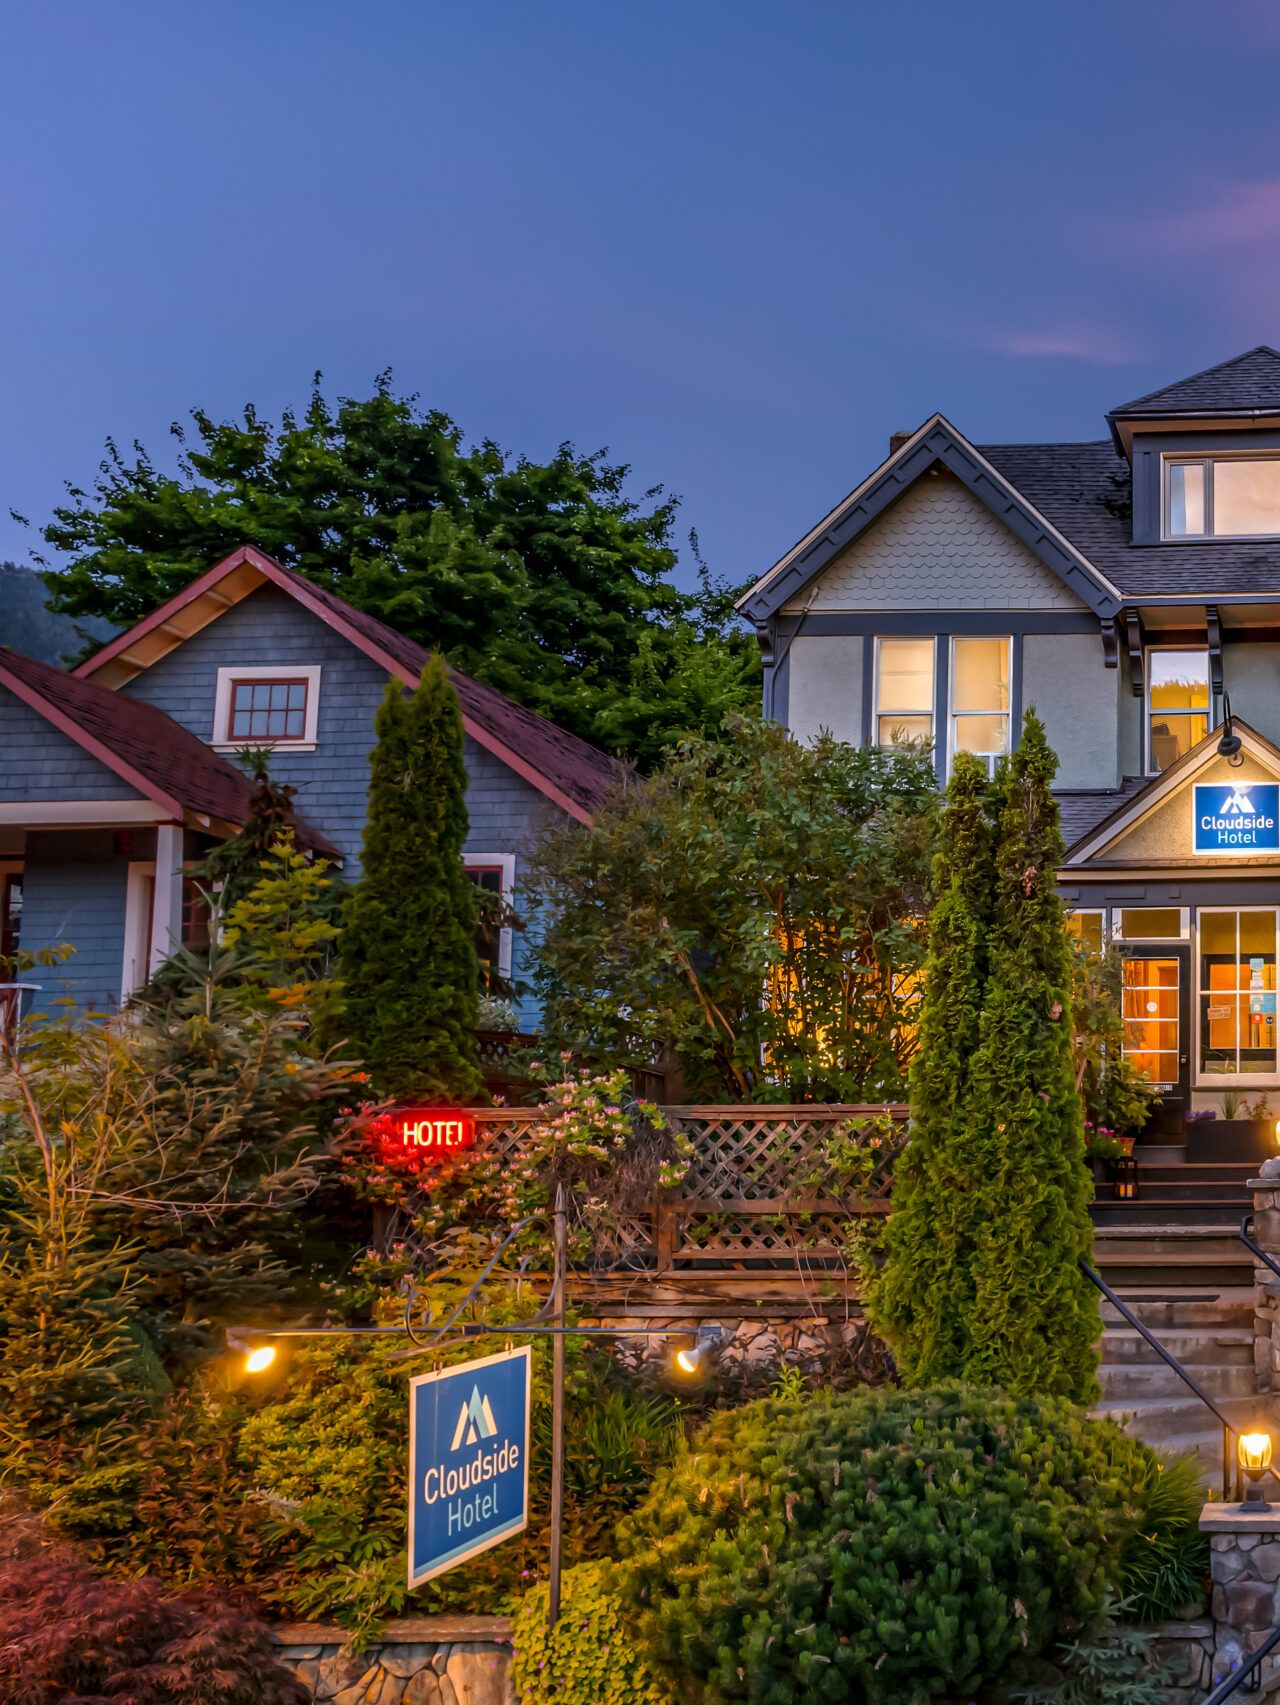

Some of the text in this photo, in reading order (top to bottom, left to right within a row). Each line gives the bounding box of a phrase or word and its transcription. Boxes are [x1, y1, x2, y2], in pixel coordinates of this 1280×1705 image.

[1201, 815, 1274, 830] Cloudside
[1218, 830, 1257, 844] Hotel
[424, 1439, 519, 1504] Cloudside
[448, 1483, 499, 1536] Hotel
